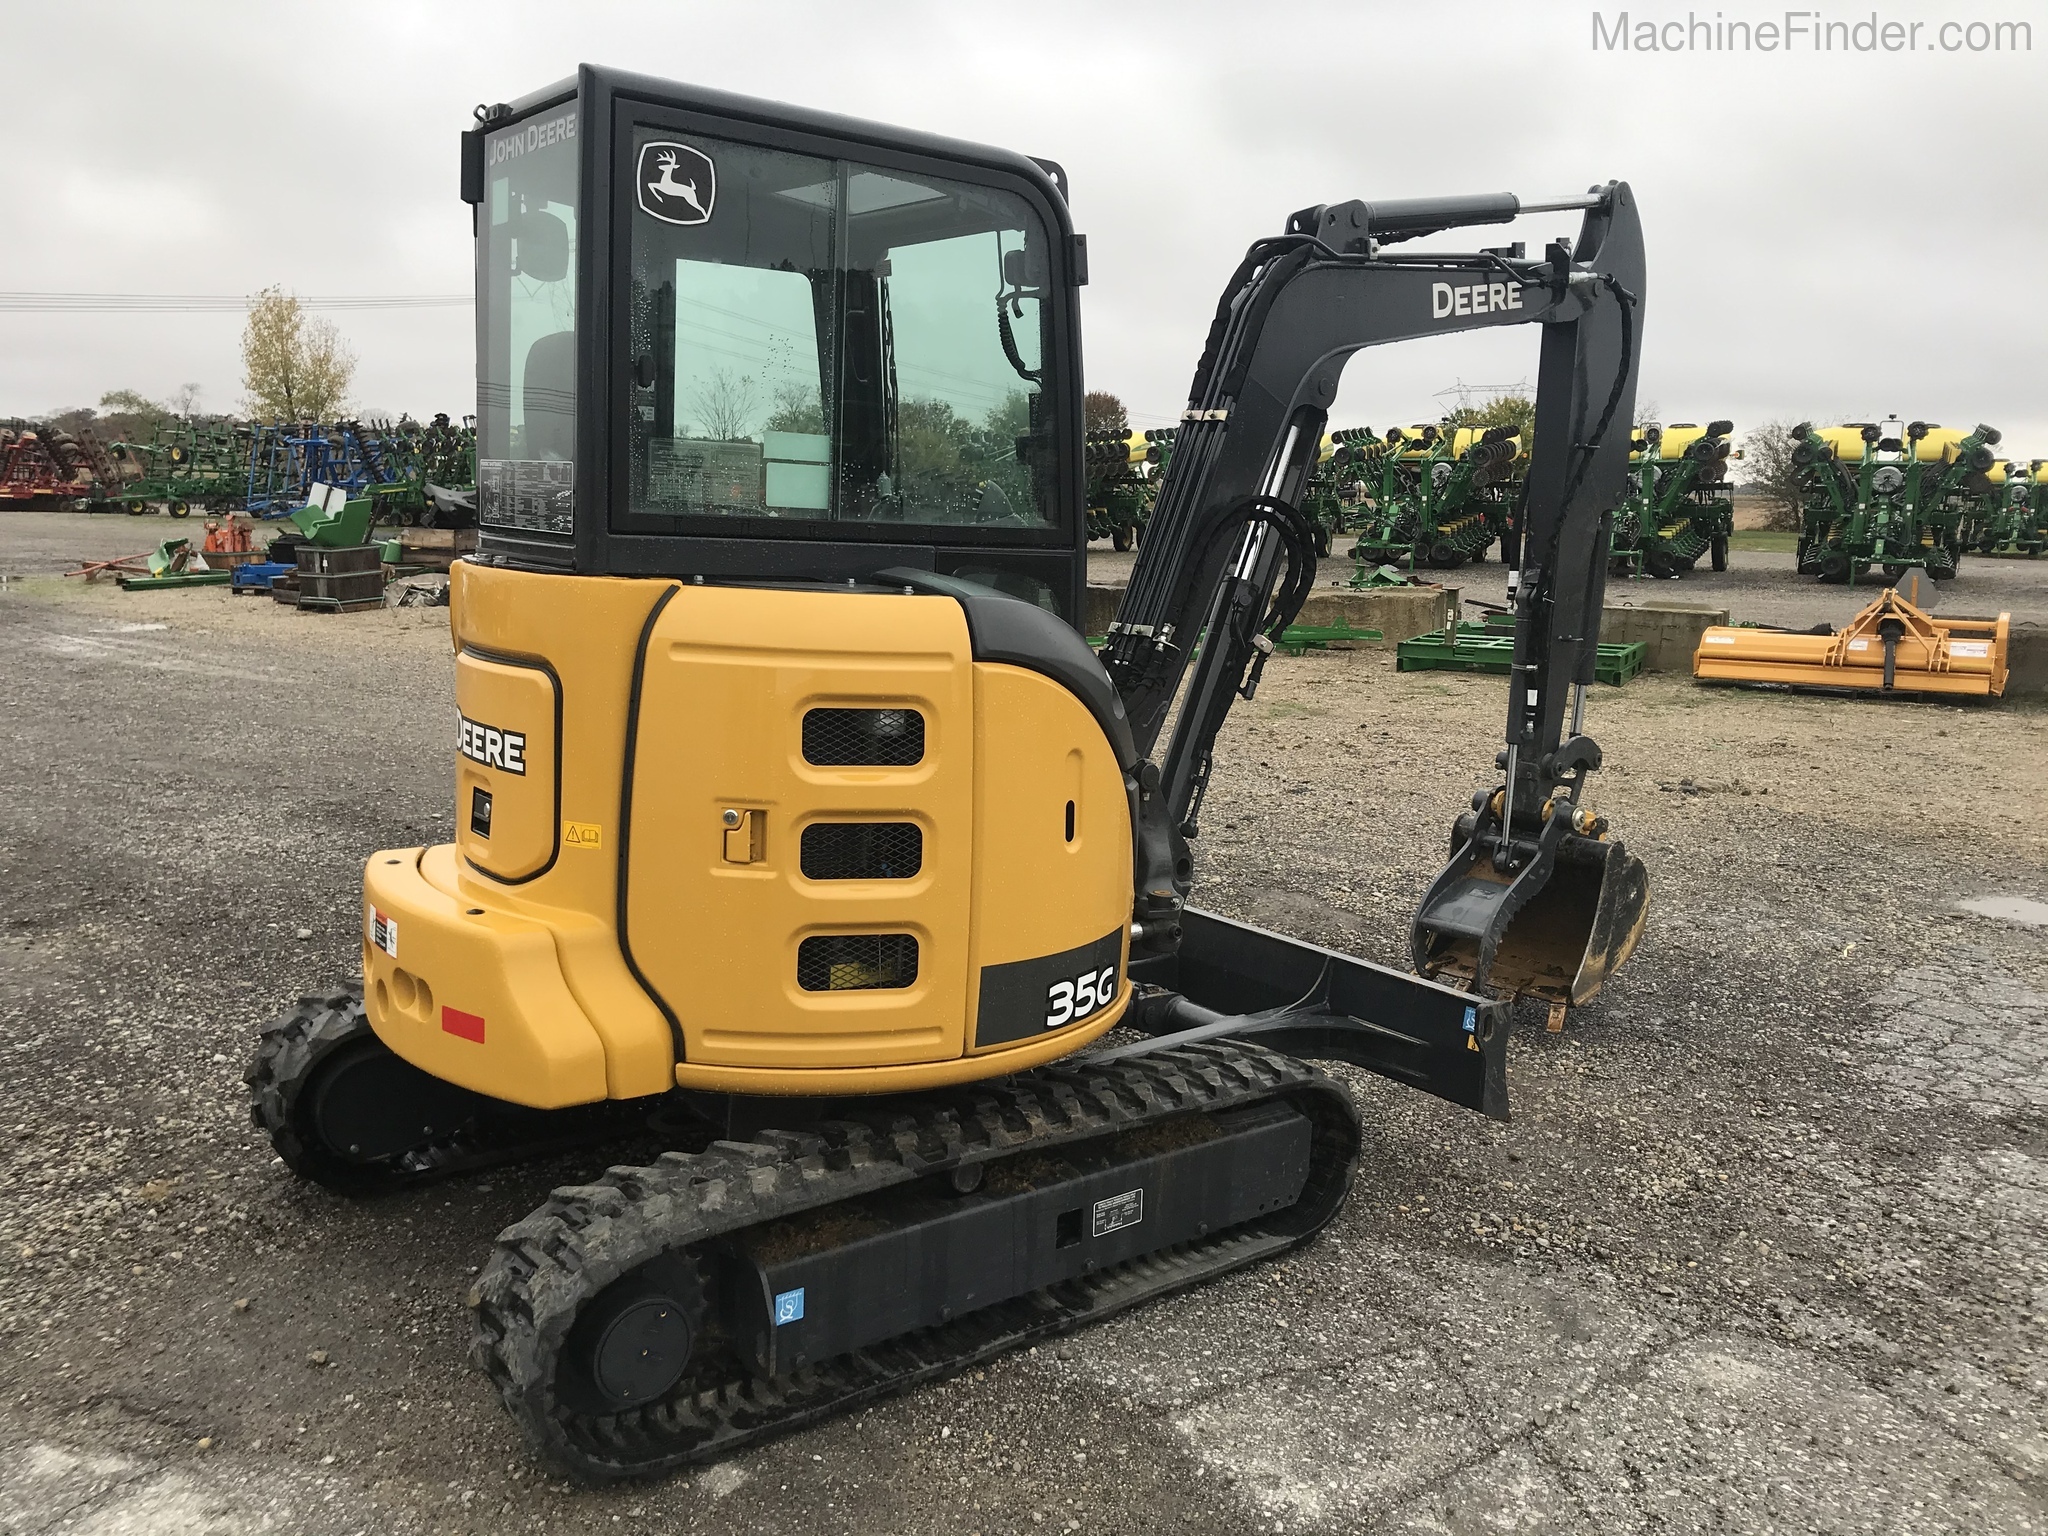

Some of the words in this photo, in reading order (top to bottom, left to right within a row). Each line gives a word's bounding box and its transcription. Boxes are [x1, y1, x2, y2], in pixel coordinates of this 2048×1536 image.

[489, 133, 526, 167] JOHN
[527, 114, 576, 153] DEERE
[1432, 281, 1523, 319] DEERE
[1046, 966, 1114, 1027] 35G
